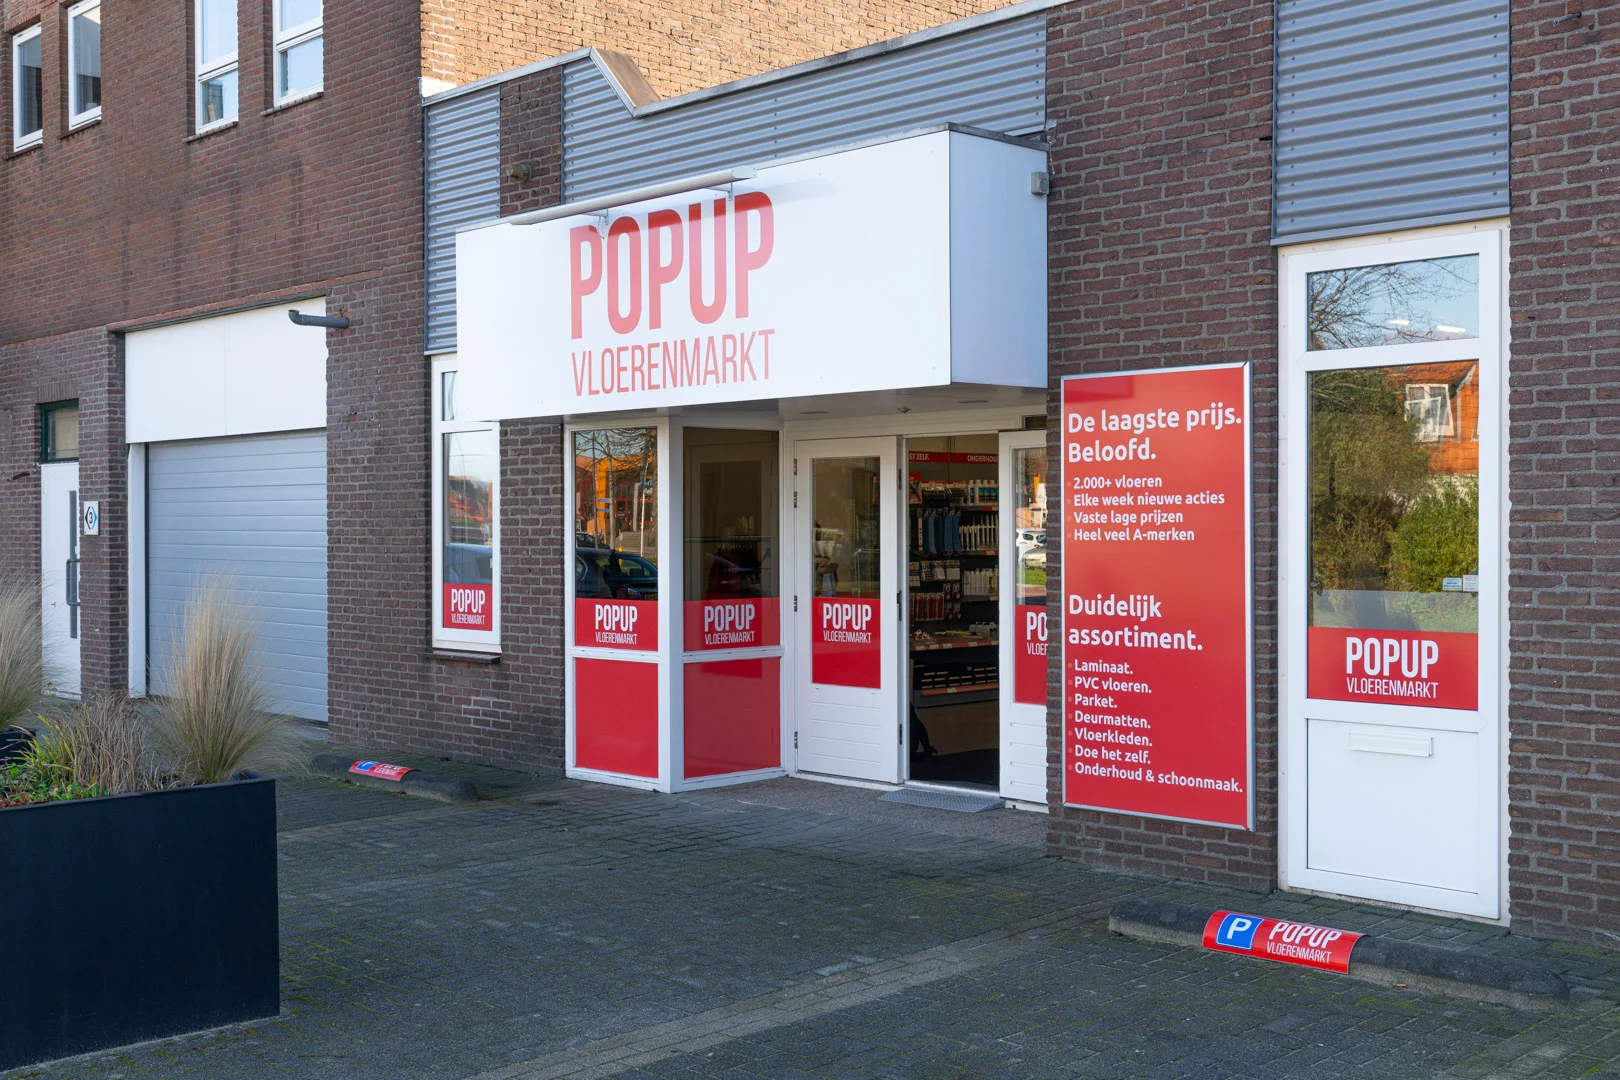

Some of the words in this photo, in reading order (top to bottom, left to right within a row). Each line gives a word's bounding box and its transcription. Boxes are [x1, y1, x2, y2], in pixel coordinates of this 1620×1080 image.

[570, 191, 774, 339] POPUP
[571, 328, 775, 396] VLOERENMARKT
[1068, 413, 1095, 433] De
[1101, 408, 1180, 434] laagste
[1186, 402, 1242, 431] prijs.
[967, 455, 998, 463] ONDERHOU
[1068, 437, 1157, 463] Beloofd.
[1073, 477, 1112, 489] 2.000+
[1115, 475, 1163, 488] vloeren
[1073, 494, 1099, 506] Elke
[1102, 493, 1134, 506] week
[1137, 492, 1182, 505] nieuwe
[1185, 491, 1225, 504] acties
[1073, 511, 1108, 524] Vaste
[1110, 510, 1137, 526] lage
[1140, 510, 1184, 526] prijzen
[1073, 528, 1101, 541] Heel
[1104, 528, 1130, 541] veel
[1133, 528, 1195, 541] A-merken
[451, 588, 486, 614] POPUP
[1069, 594, 1162, 621] Duidelijk
[451, 613, 485, 625] VLOERENMARKT
[595, 604, 637, 632] POPUP
[704, 604, 755, 633] POPUP
[823, 603, 872, 631] POPUP
[595, 631, 637, 645] VLOERENMARKT
[704, 631, 755, 645] VLOERENMARKT
[823, 630, 872, 644] VLOERENMARKT
[1068, 626, 1203, 651] assortiment.
[1074, 659, 1134, 675] Laminaat.
[1346, 636, 1439, 679] POPUP
[1074, 676, 1099, 690] PVC
[1101, 678, 1152, 694] vloeren.
[1346, 677, 1439, 698] VLOERENMARKT
[1074, 693, 1118, 709] Parket.
[1074, 710, 1151, 729] Deurmatten.
[1074, 727, 1153, 747] Vloerkleden.
[1075, 744, 1099, 759] Doe
[1101, 746, 1122, 761] het
[1124, 749, 1151, 764] zelf.
[1075, 761, 1142, 782] Onderhoud
[1145, 770, 1155, 783] &
[1158, 771, 1243, 793] schoonmaak.
[1226, 917, 1252, 940] P
[1268, 921, 1342, 949] POPUP
[1266, 941, 1332, 964] VLOERENMARKT
